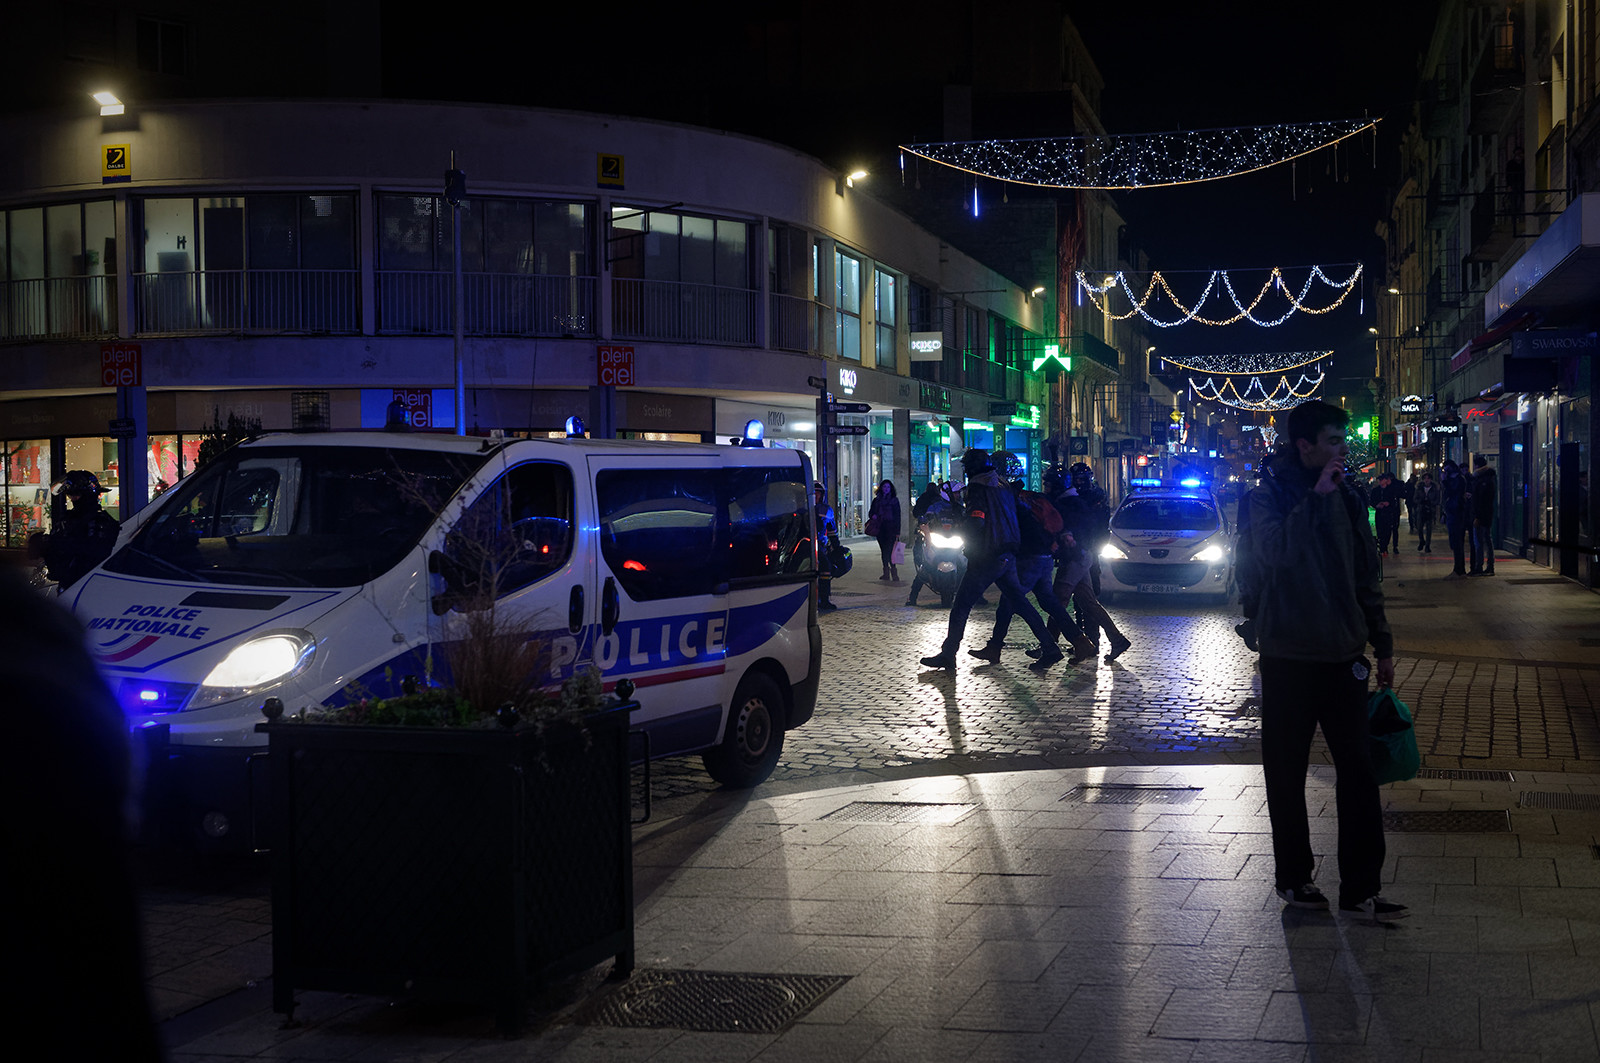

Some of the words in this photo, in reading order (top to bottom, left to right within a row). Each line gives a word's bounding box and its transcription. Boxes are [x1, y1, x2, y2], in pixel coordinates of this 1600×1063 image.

[911, 340, 942, 350] KIKO
[102, 346, 137, 367] plein
[601, 347, 634, 366] plein
[103, 362, 138, 385] ciel
[600, 361, 634, 385] ciel
[840, 368, 857, 389] KIKO
[204, 401, 263, 415] Breau
[408, 405, 431, 428] iel
[642, 404, 672, 418] Scolaire
[122, 604, 202, 621] POLICE
[86, 617, 210, 640] NATIONALE
[551, 617, 726, 679] POLICE
